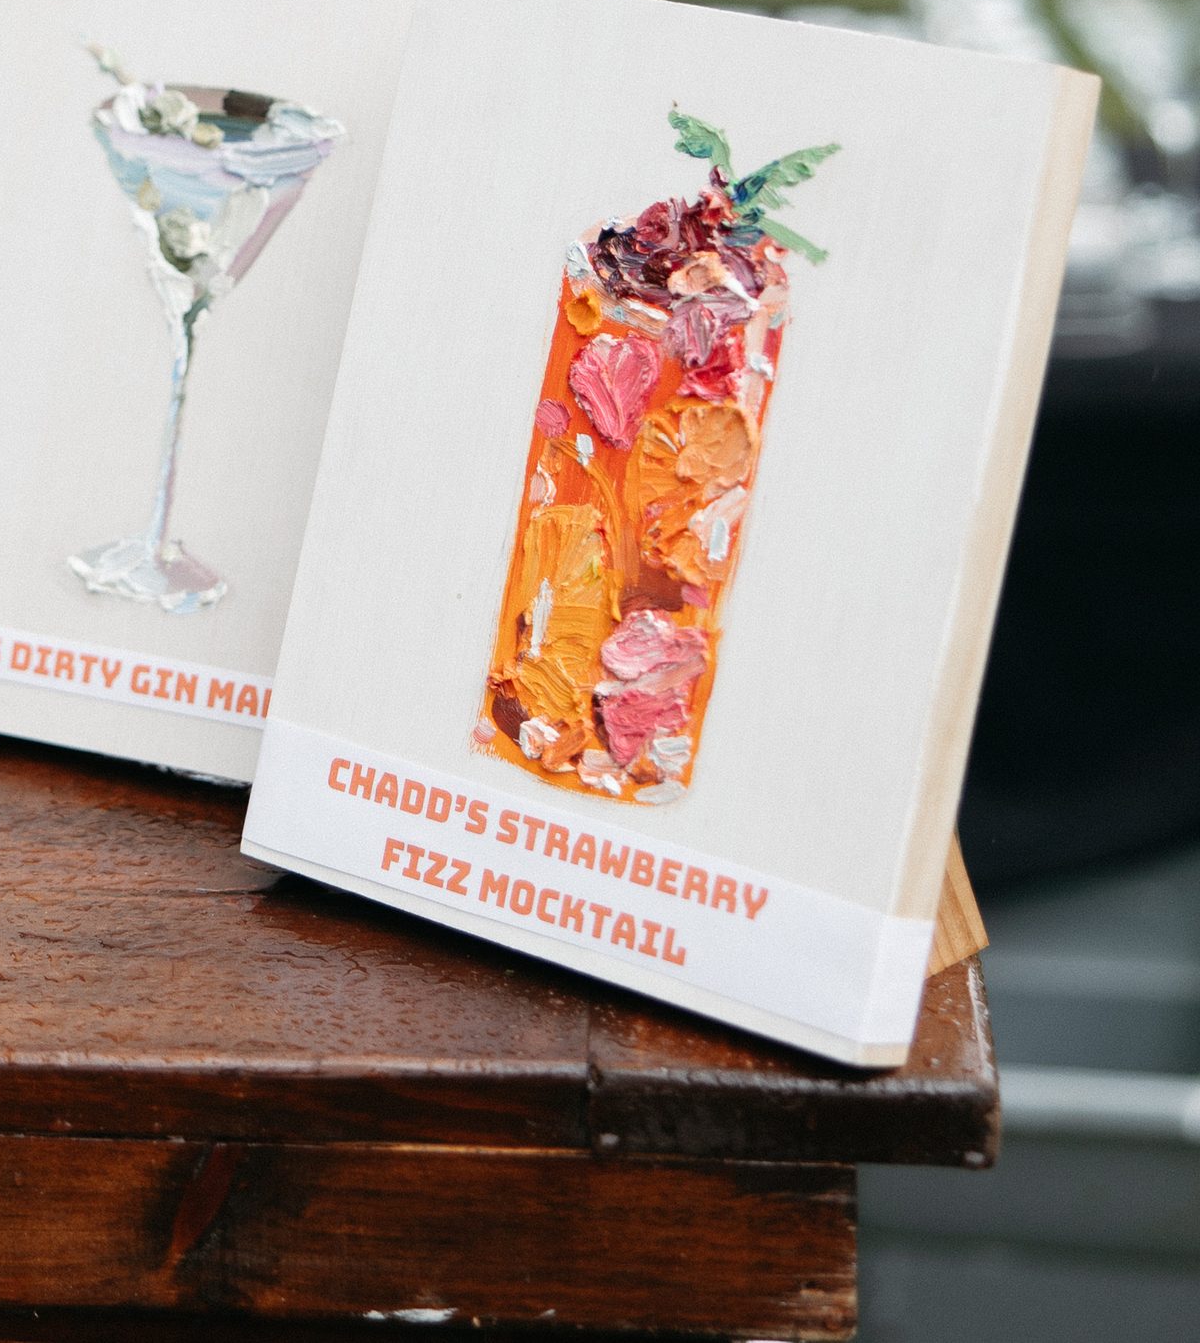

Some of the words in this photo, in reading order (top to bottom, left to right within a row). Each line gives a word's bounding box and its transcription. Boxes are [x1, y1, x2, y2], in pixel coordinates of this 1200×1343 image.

[9, 641, 123, 690] DIRTY
[129, 663, 200, 707] GIN
[327, 757, 491, 836] CHADD'S
[495, 808, 770, 922] STRAWBERRY
[380, 837, 473, 897] FIZZ
[478, 868, 688, 967] MOCKTAIL
